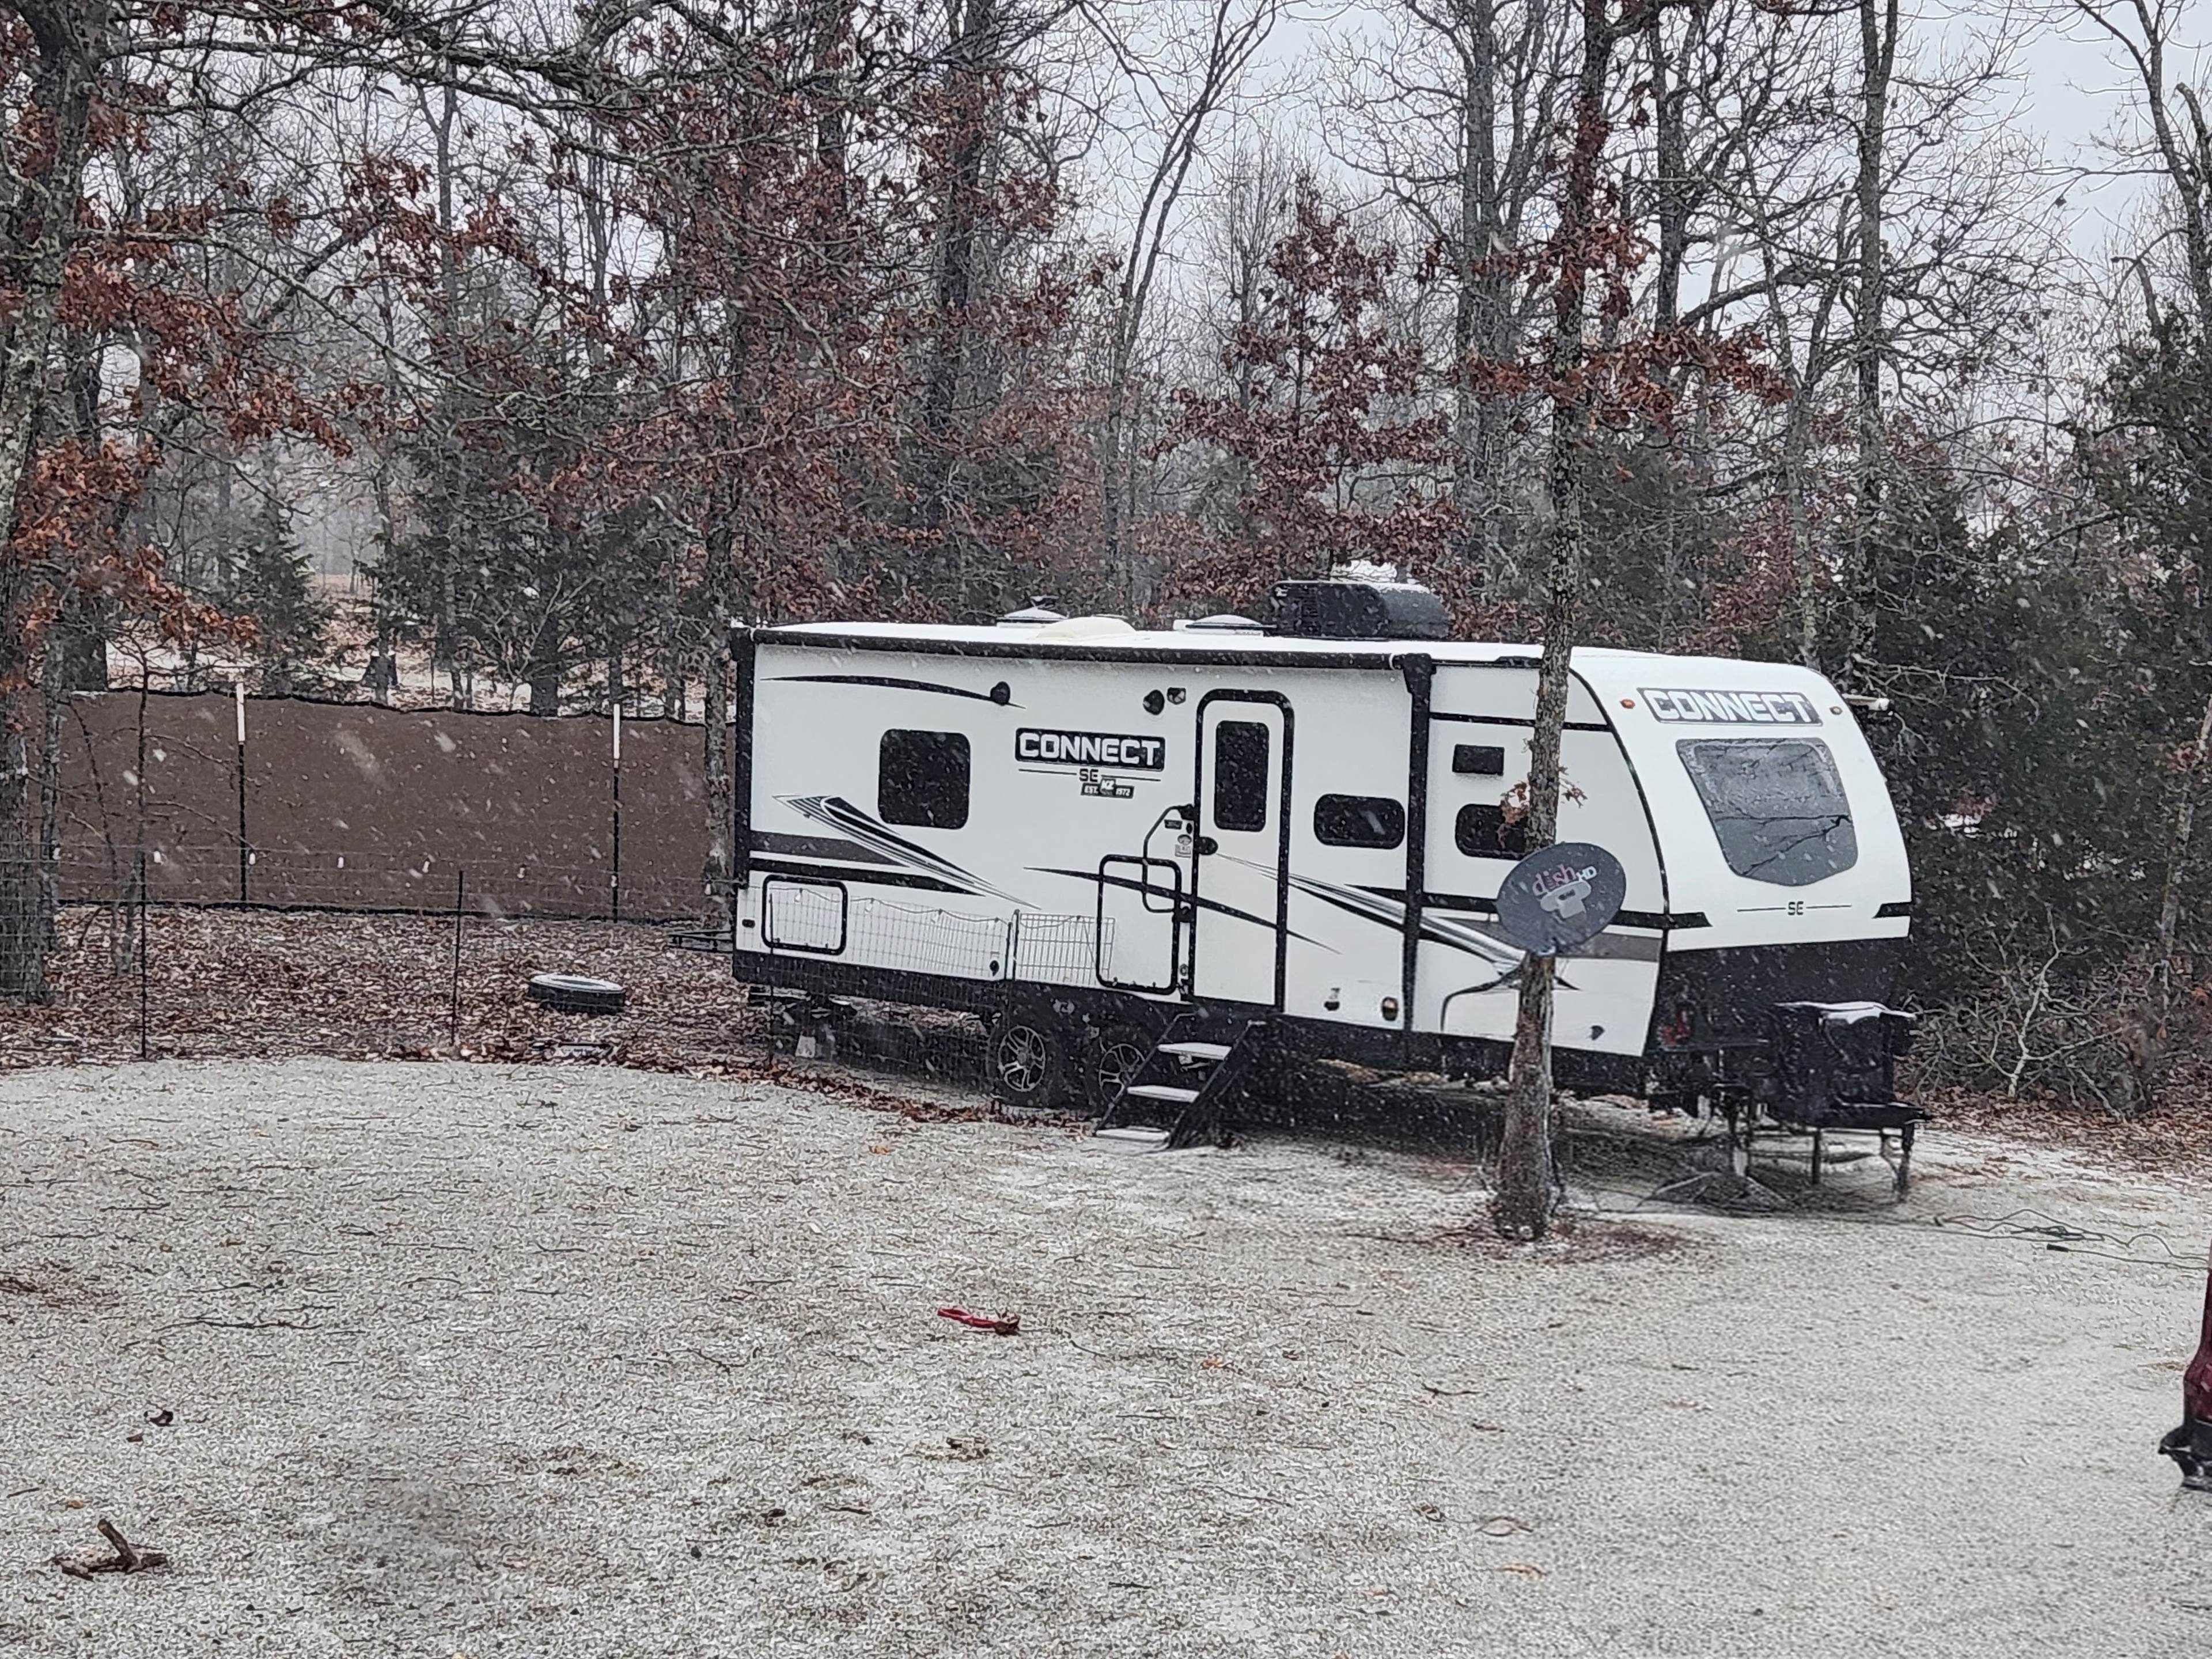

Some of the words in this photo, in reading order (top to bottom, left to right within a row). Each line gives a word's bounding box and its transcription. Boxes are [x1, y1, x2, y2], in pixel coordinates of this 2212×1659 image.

[1643, 689, 1815, 724] CONNECT
[1018, 732, 1161, 766] CONNECT
[1079, 768, 1099, 783] SE
[1787, 900, 1804, 916] SE
